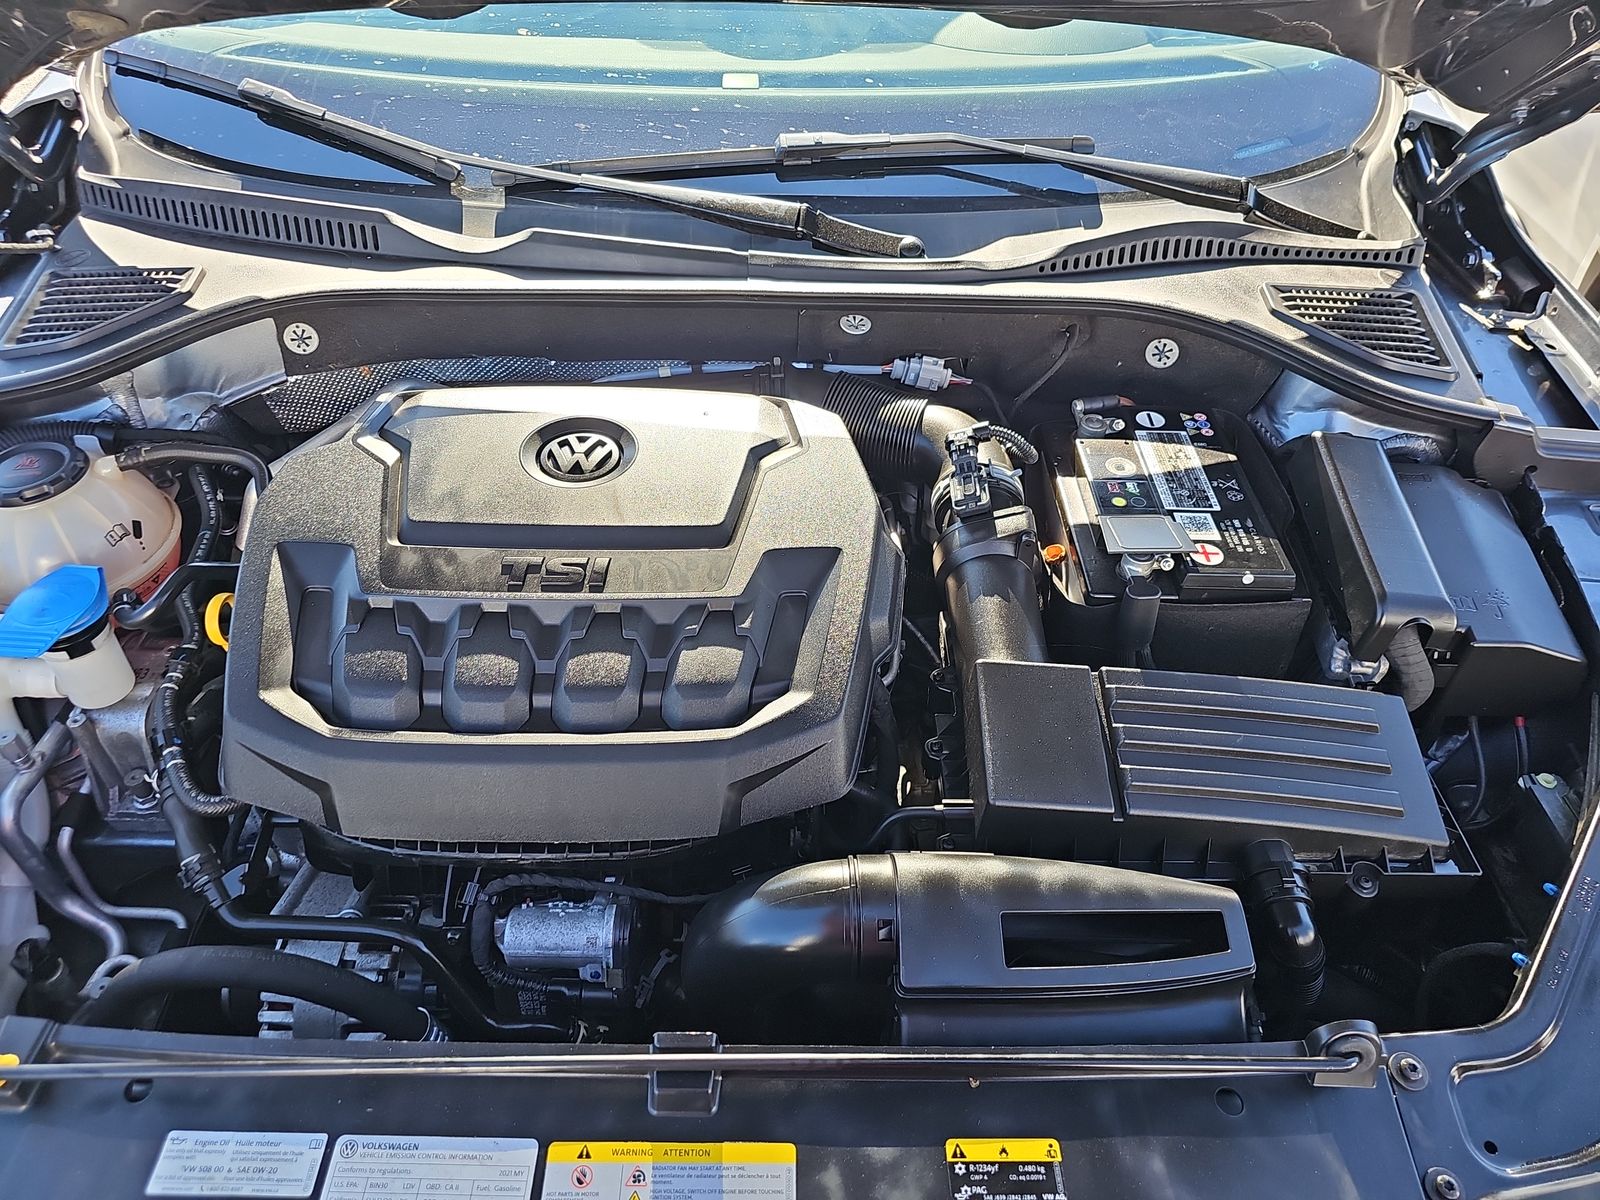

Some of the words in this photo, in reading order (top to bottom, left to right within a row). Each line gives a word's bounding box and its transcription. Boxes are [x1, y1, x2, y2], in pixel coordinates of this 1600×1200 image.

[541, 433, 619, 478] VW
[501, 556, 612, 592] TSI
[194, 1139, 218, 1148] Engine
[235, 1139, 254, 1147] Huile
[361, 1142, 420, 1151] VOLKSWAGEN
[611, 1148, 654, 1157] WARNING
[662, 1149, 711, 1157] ATTENTION
[969, 1164, 999, 1174] R-1234yf
[1018, 1164, 1036, 1172] 0.480
[1037, 1165, 1046, 1174] kg
[971, 1186, 988, 1194] PAG
